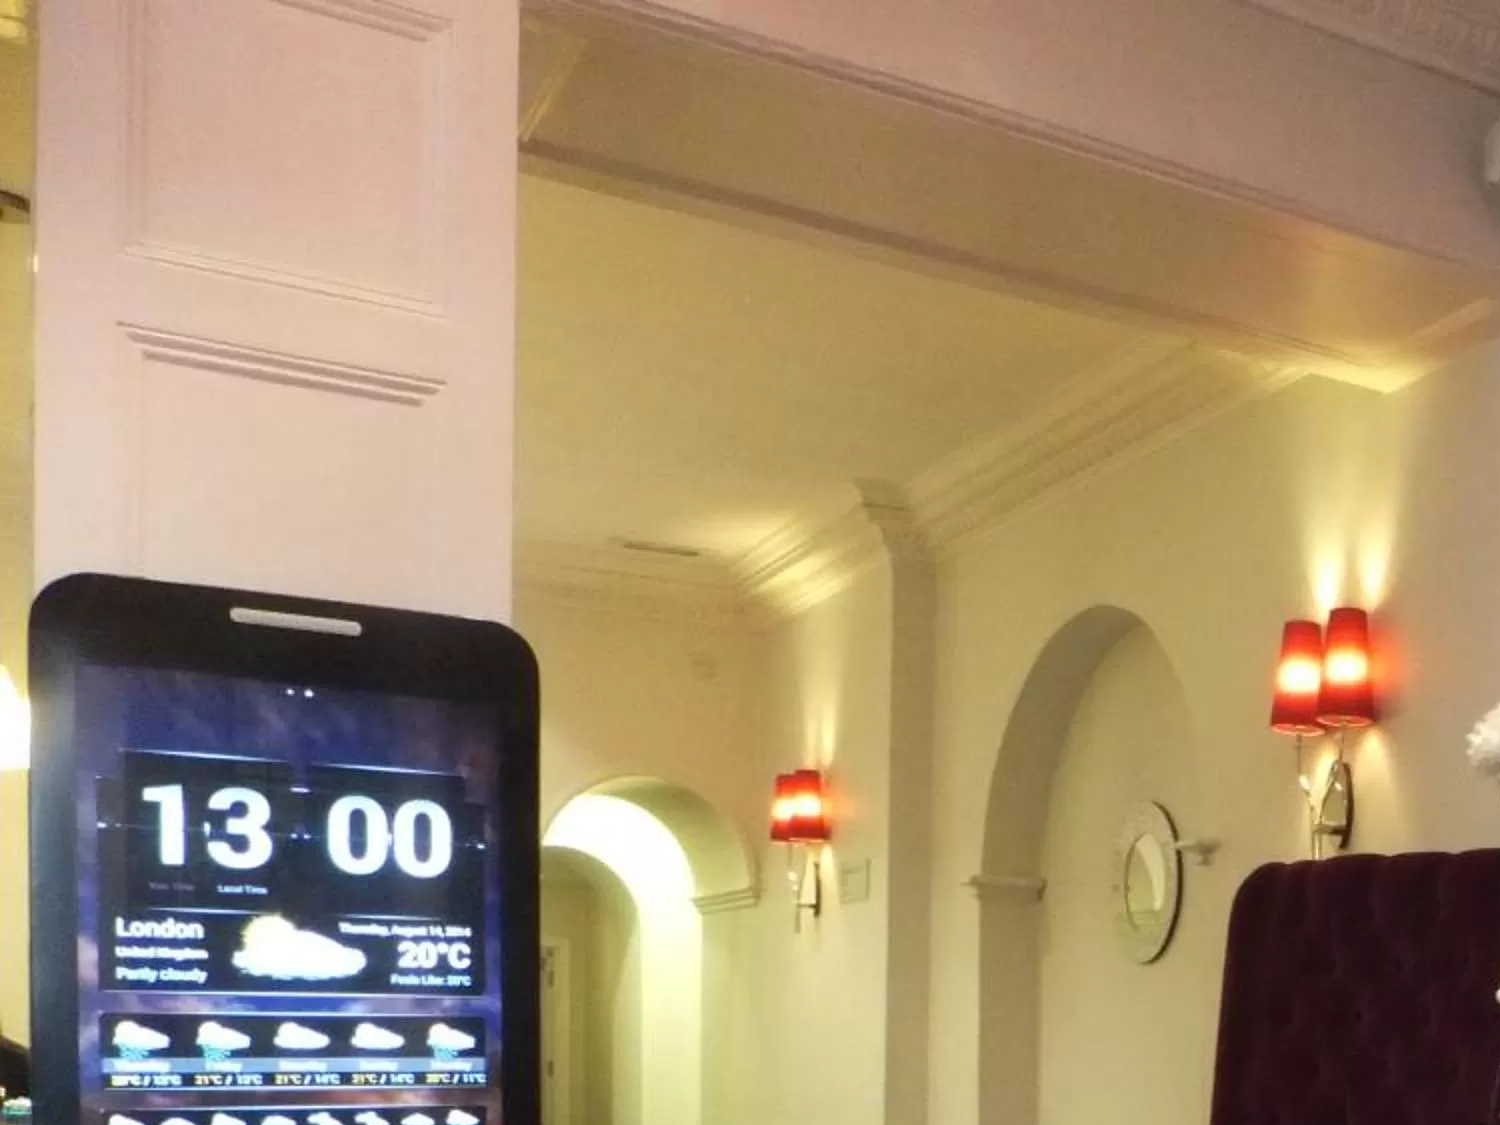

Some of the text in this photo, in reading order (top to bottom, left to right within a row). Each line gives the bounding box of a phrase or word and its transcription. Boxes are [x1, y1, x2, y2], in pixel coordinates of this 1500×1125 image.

[141, 783, 453, 879] 13 00
[115, 916, 205, 940] London
[397, 940, 472, 969] 20°C
[159, 967, 208, 985] cloudy
